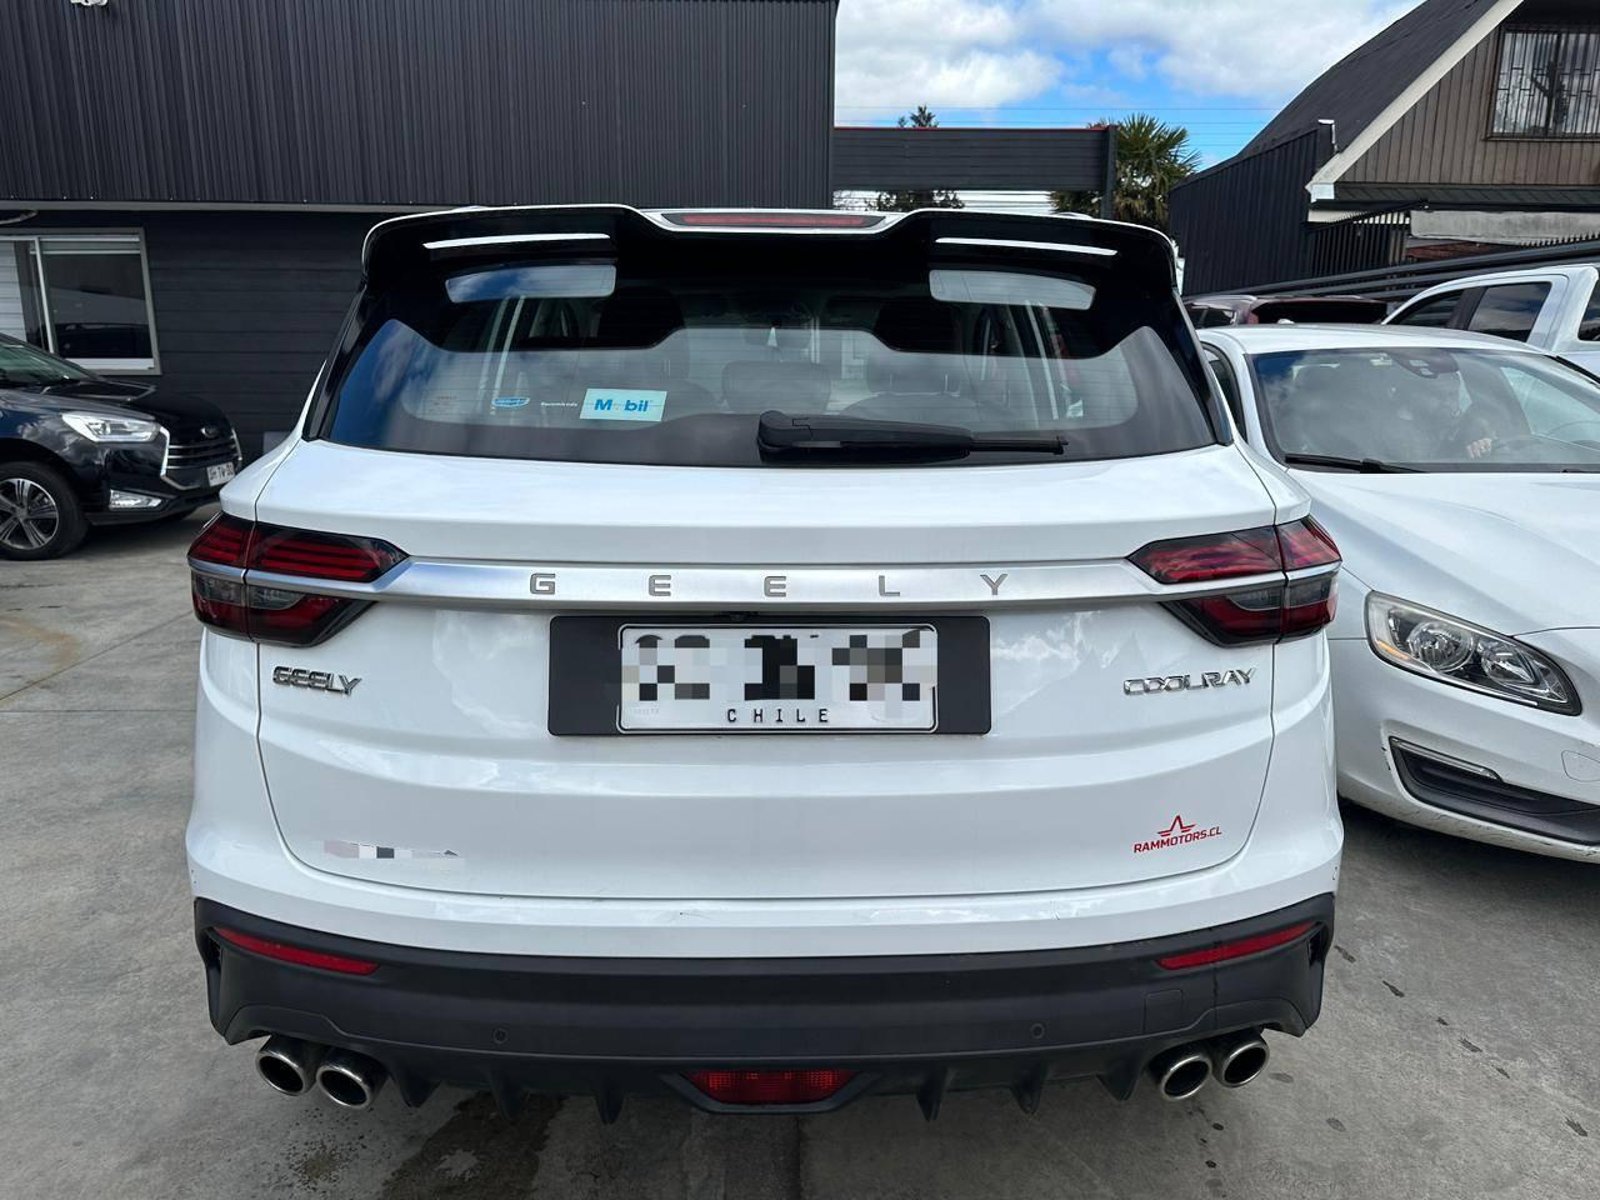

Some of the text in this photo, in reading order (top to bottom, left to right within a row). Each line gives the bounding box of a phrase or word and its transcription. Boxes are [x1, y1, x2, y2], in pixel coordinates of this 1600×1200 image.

[529, 573, 1008, 597] GEELY
[272, 665, 362, 696] GEELY
[1123, 667, 1257, 696] COOLRAY
[727, 708, 828, 723] CHILE
[1133, 826, 1222, 853] RAMMOTORS.CL
